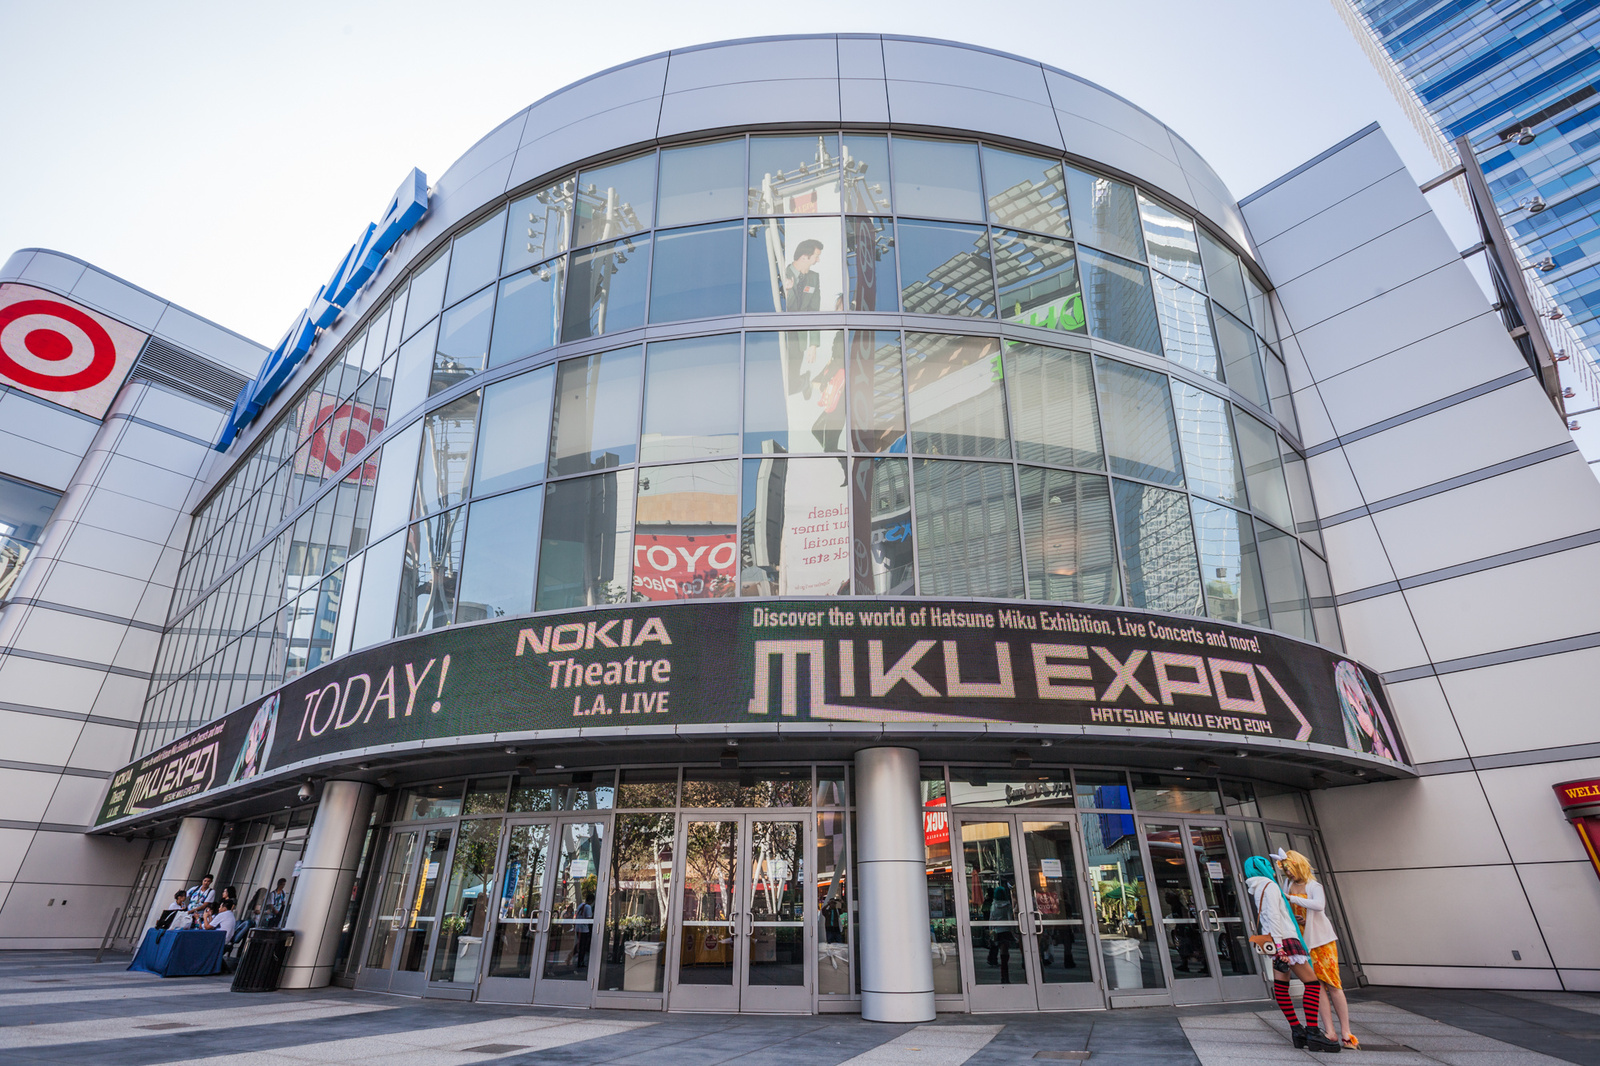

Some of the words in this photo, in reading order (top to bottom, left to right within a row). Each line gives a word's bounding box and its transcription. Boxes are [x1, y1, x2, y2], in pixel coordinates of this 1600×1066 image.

[515, 617, 673, 657] NOKIA
[753, 607, 825, 627] Discover
[828, 606, 855, 627] the
[859, 606, 906, 627] world
[910, 606, 927, 627] of
[930, 607, 995, 628] Hatsune
[999, 609, 1037, 630] Miku
[1040, 611, 1116, 636] Exhibition,
[1116, 616, 1147, 638] Live
[1149, 621, 1204, 645] Concerts
[1206, 631, 1228, 648] and
[1229, 636, 1262, 654] more!
[547, 655, 672, 689] Theatre
[748, 639, 1016, 718] MIKU
[1030, 642, 1267, 715] EXPO
[296, 653, 451, 742] TODAY!
[572, 693, 613, 717] L.A.
[619, 690, 671, 714] LIVE
[1090, 707, 1166, 725] HATSUNE
[1168, 712, 1203, 728] MIKU
[1205, 717, 1242, 731] EXPO
[1244, 718, 1273, 734] 2014
[123, 763, 169, 814] MIKU
[160, 742, 216, 794] EXPO
